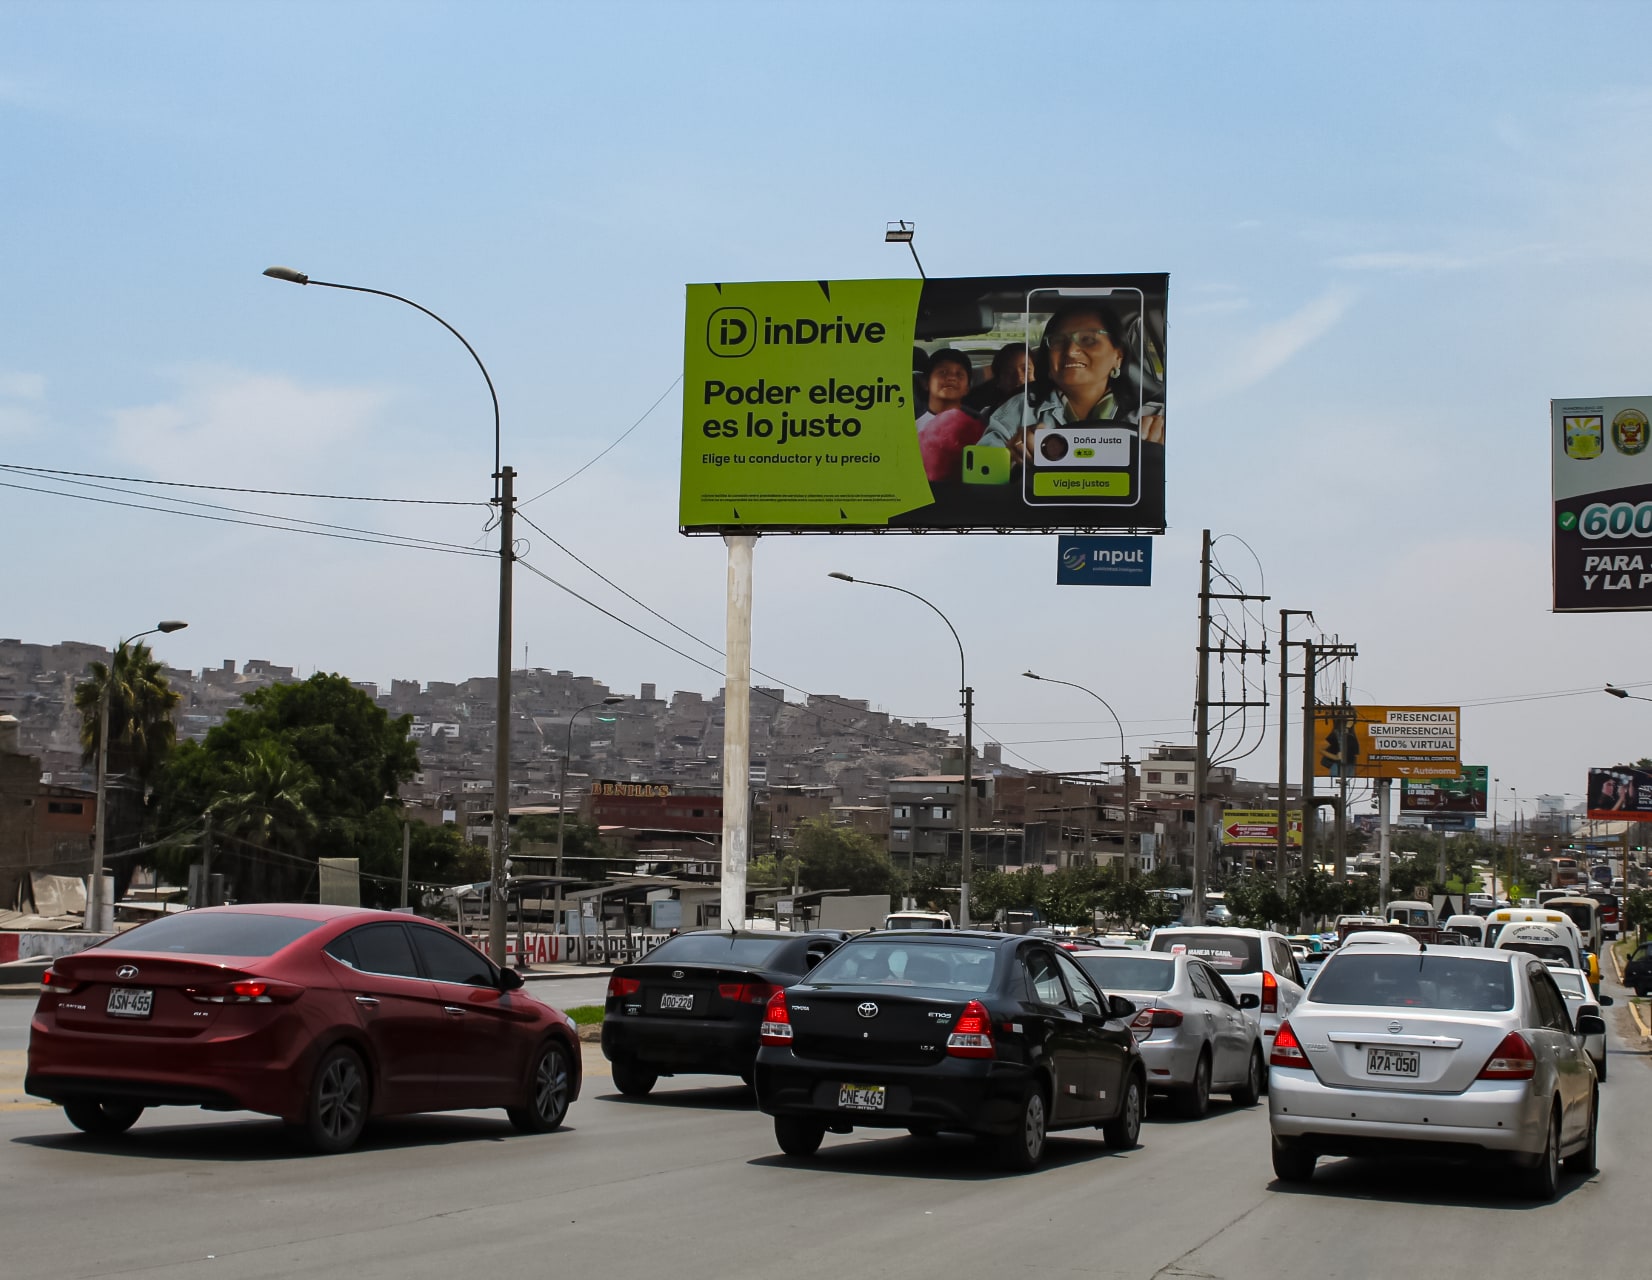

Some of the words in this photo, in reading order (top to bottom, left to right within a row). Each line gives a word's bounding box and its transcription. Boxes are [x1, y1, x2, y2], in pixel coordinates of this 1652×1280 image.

[764, 315, 886, 345] inDrive
[704, 379, 801, 405] Poder
[809, 377, 905, 410] elegir,
[703, 418, 739, 438] es
[746, 411, 773, 437] lo
[777, 411, 862, 445] justo
[1073, 436, 1096, 444] Doña
[1098, 436, 1122, 444] Justa
[702, 453, 731, 467] Elige
[733, 454, 745, 464] tu
[749, 453, 812, 464] conductor
[815, 455, 822, 466] y
[825, 453, 838, 464] tu
[841, 453, 881, 467] precio
[1052, 478, 1080, 490] Viajes
[1082, 478, 1110, 490] justos
[1579, 501, 1652, 539] 600
[1093, 549, 1144, 565] input
[1584, 555, 1644, 572] PARA
[1583, 575, 1599, 590] Y
[1603, 573, 1632, 590] LA
[1389, 712, 1455, 722] PRESENCIAL
[1370, 725, 1455, 735] SEMIPRESENCIAL
[1379, 739, 1408, 749] 100%
[1410, 740, 1455, 749] VIRTUAL
[108, 994, 150, 1012] ASN-455
[1370, 1055, 1418, 1073] A7A-050
[840, 1089, 884, 1106] CNE-463
